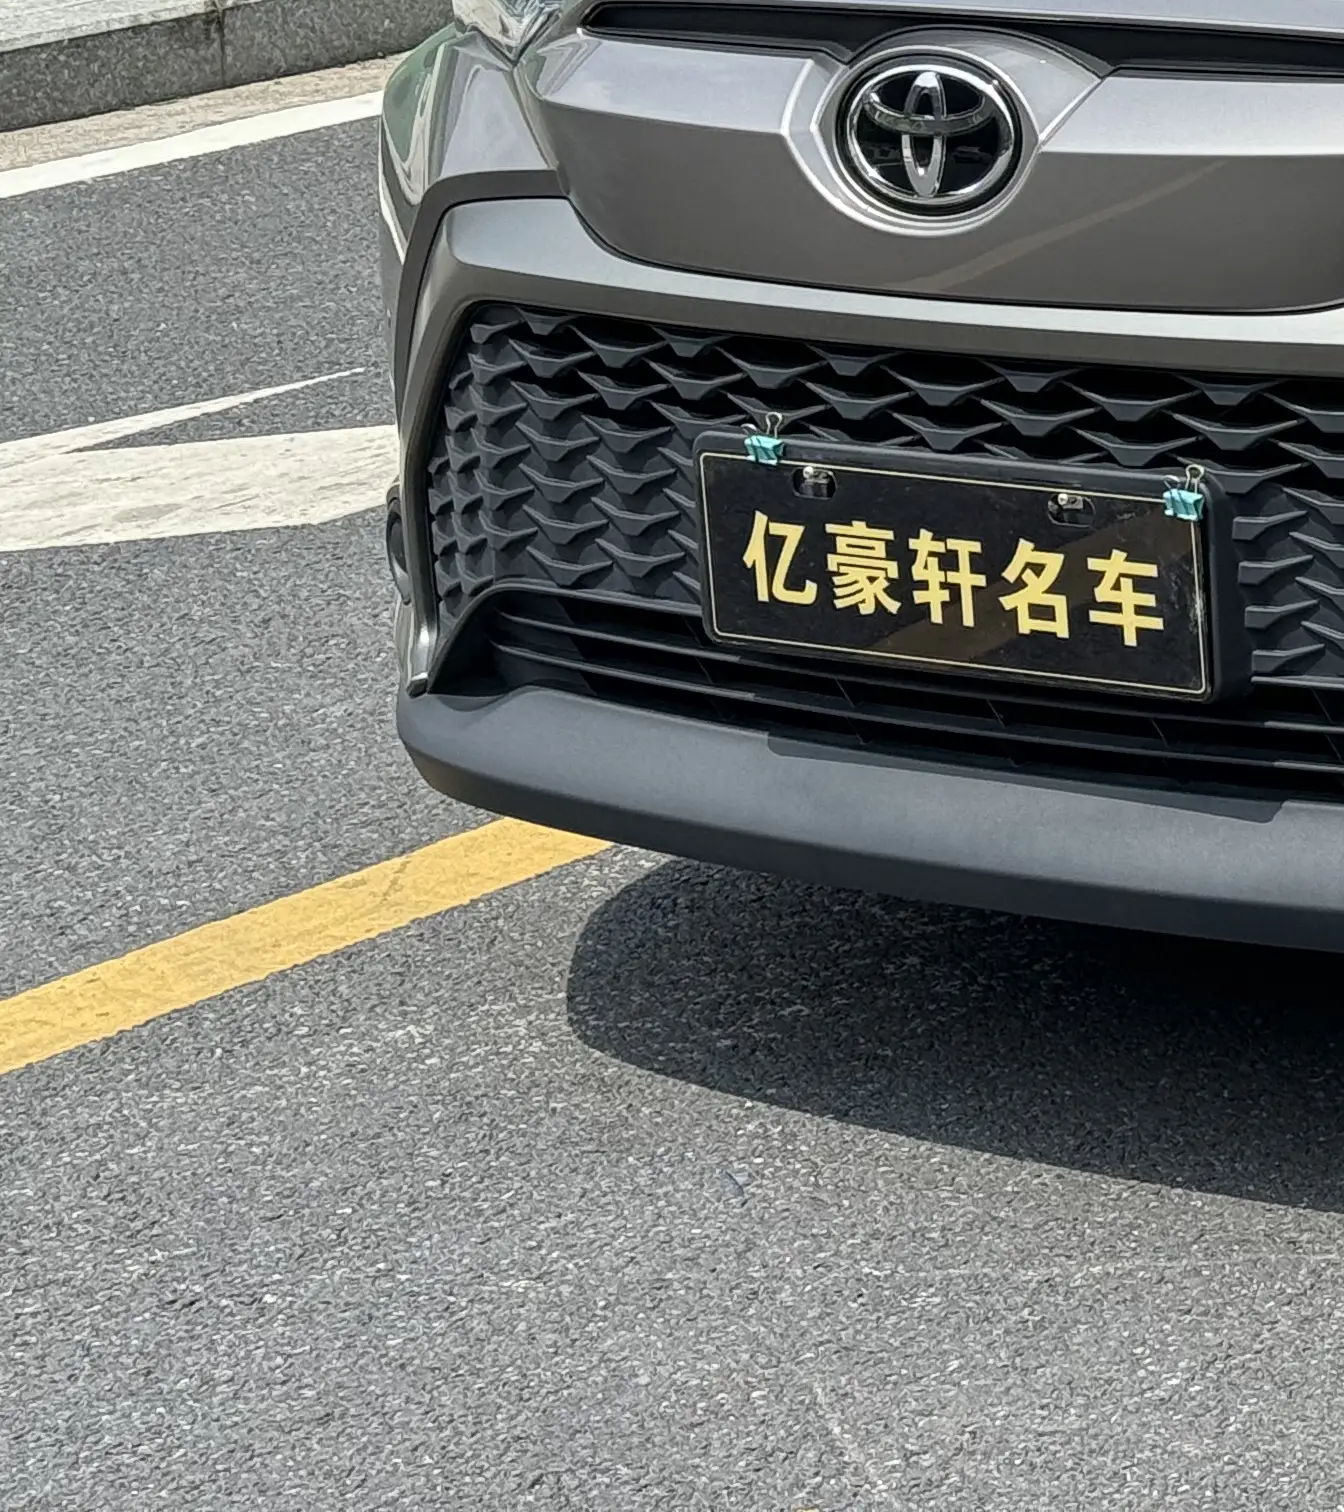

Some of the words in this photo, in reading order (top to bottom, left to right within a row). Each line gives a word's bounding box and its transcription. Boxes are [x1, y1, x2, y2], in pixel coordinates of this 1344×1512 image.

[743, 510, 1165, 648] 亿豪轩名车
